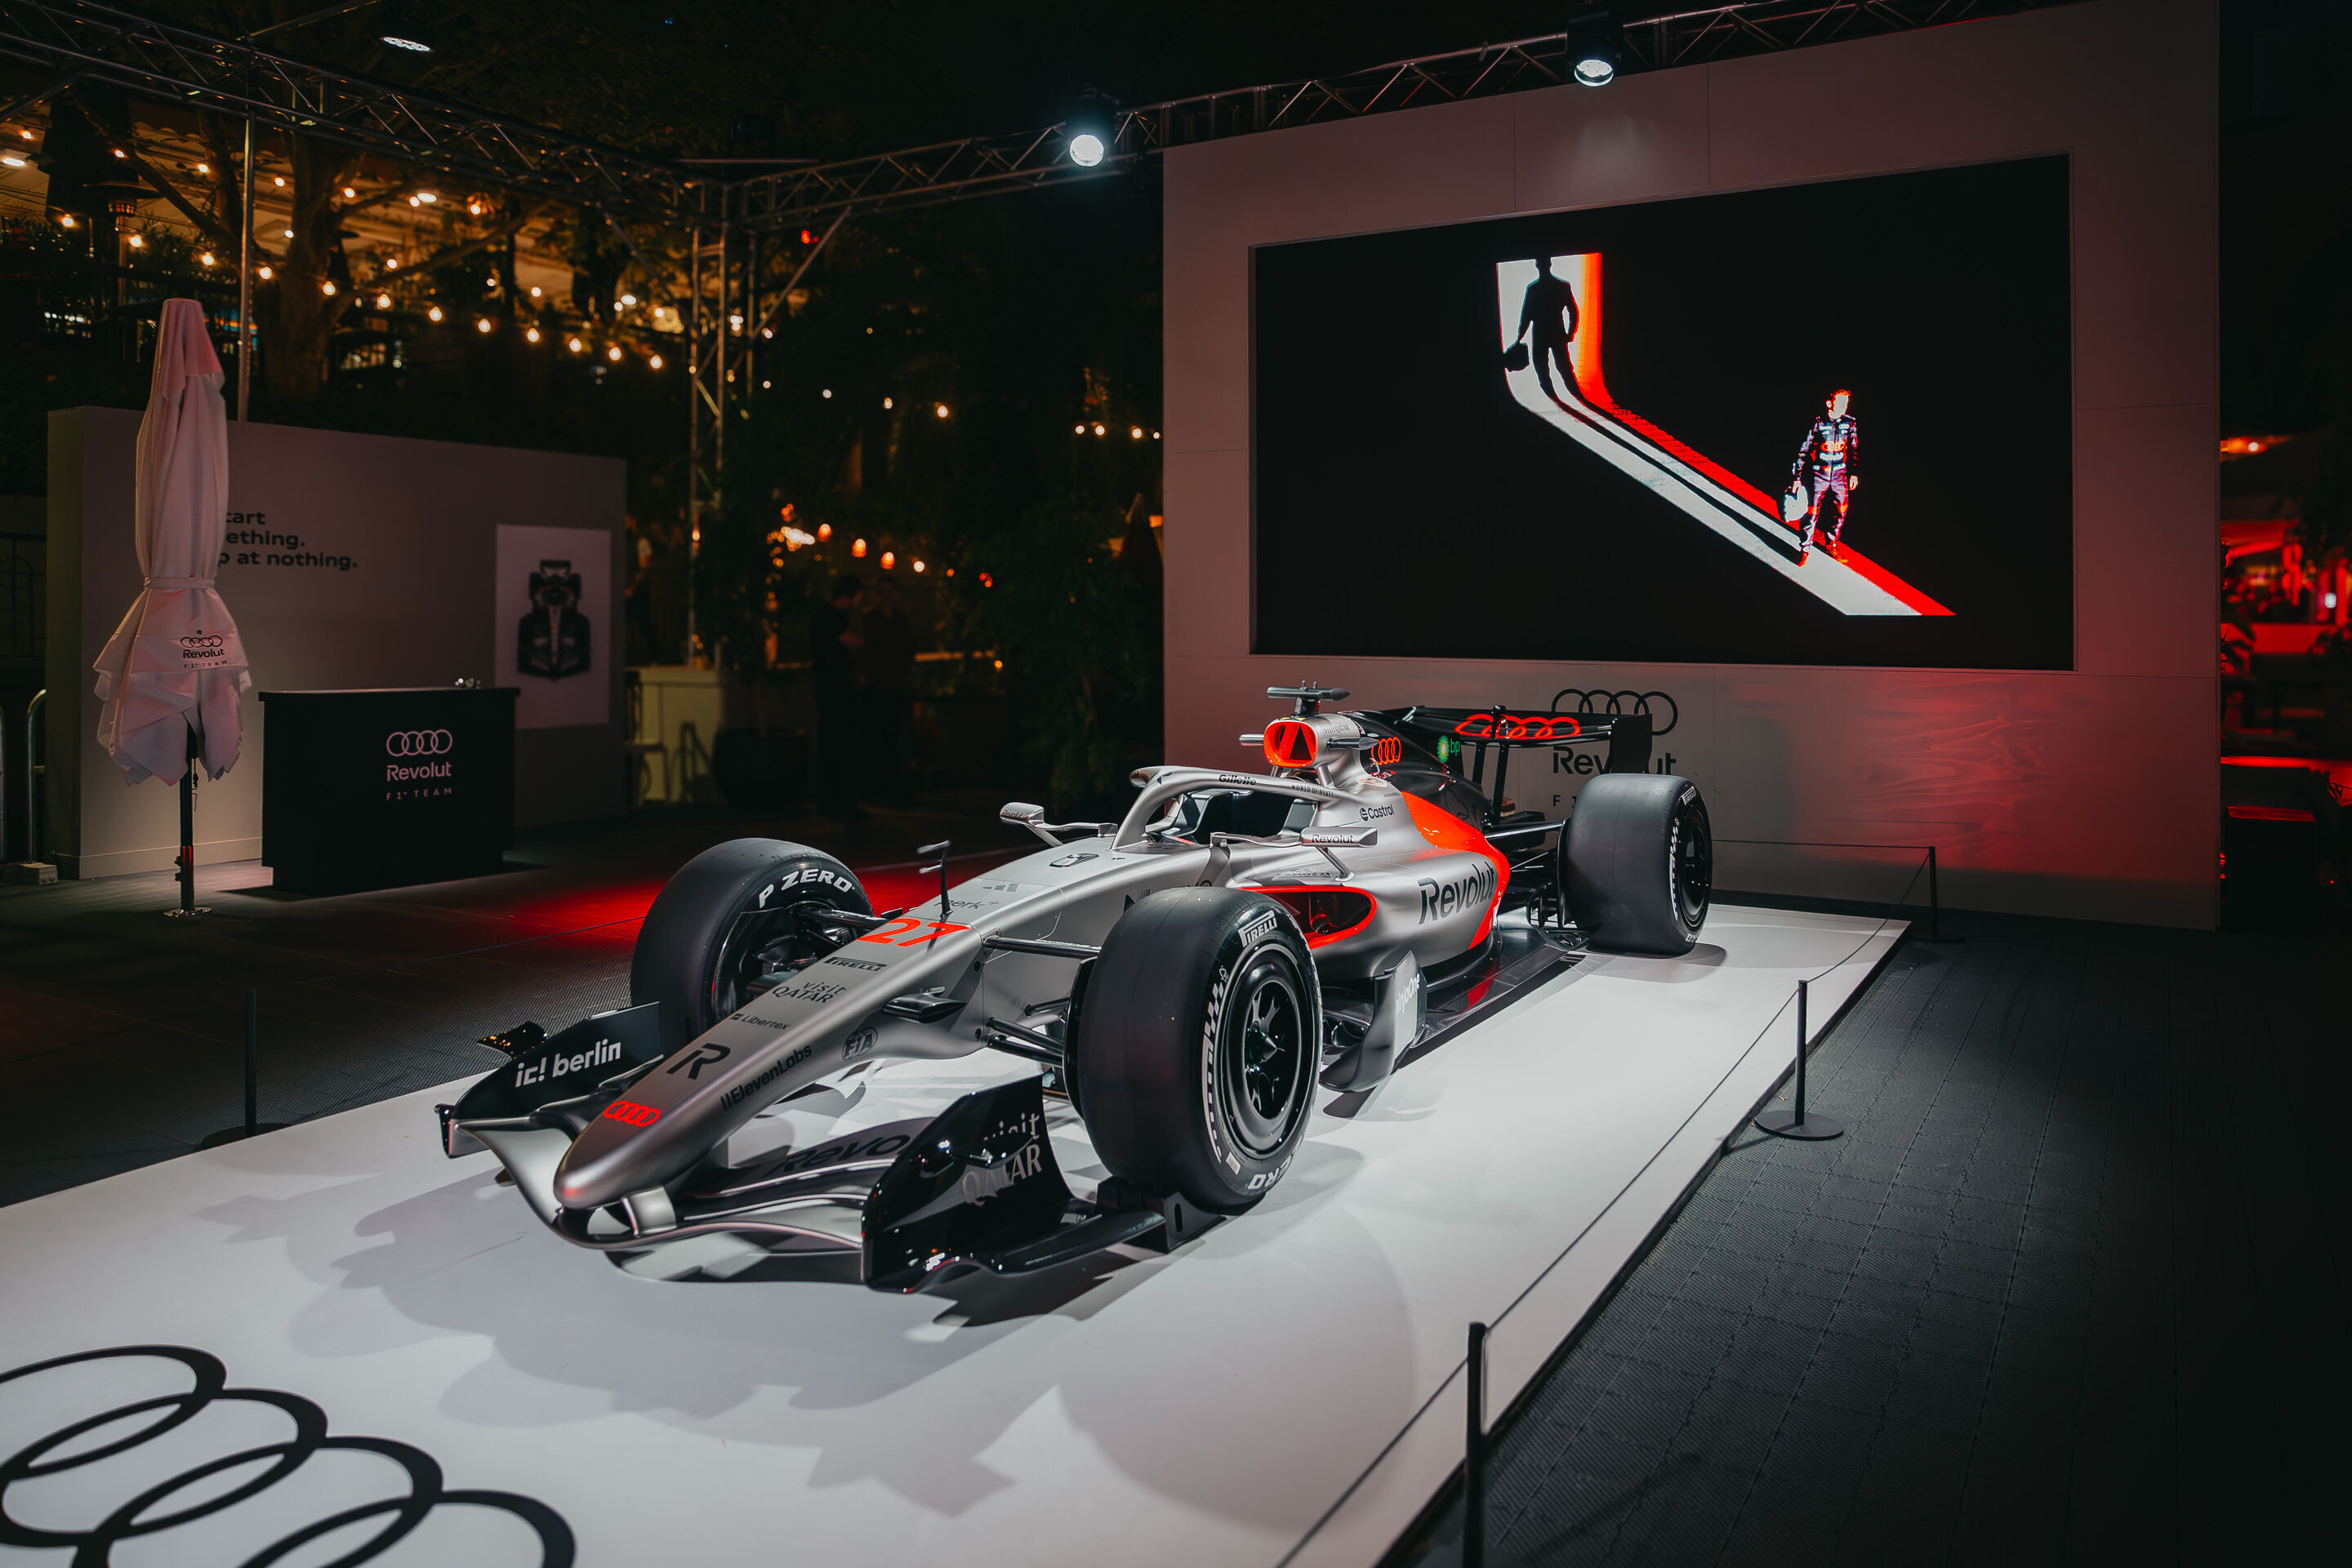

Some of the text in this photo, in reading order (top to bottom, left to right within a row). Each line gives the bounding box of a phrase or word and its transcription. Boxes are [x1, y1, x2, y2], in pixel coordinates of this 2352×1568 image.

[226, 511, 266, 525] art
[225, 530, 305, 550] ething.
[237, 551, 260, 565] at
[267, 552, 358, 571] nothing.
[182, 648, 225, 658] Revolut
[1450, 738, 1461, 756] bp
[1552, 746, 1677, 775] Revut
[386, 761, 452, 782] Revolut
[1218, 773, 1257, 786] Gillette
[414, 787, 452, 798] TEAM
[1367, 804, 1395, 819] Castrol
[1312, 834, 1354, 844] Revolut
[759, 869, 853, 908] P ZERO
[1417, 861, 1495, 924] Revolut
[856, 918, 970, 947] 27
[1238, 910, 1277, 947] PIRELLI
[823, 956, 887, 972] PIRELLI
[773, 986, 834, 1004] QATAR
[803, 982, 848, 995] visit
[742, 1015, 791, 1031] Libertex
[552, 1038, 621, 1078] berlin
